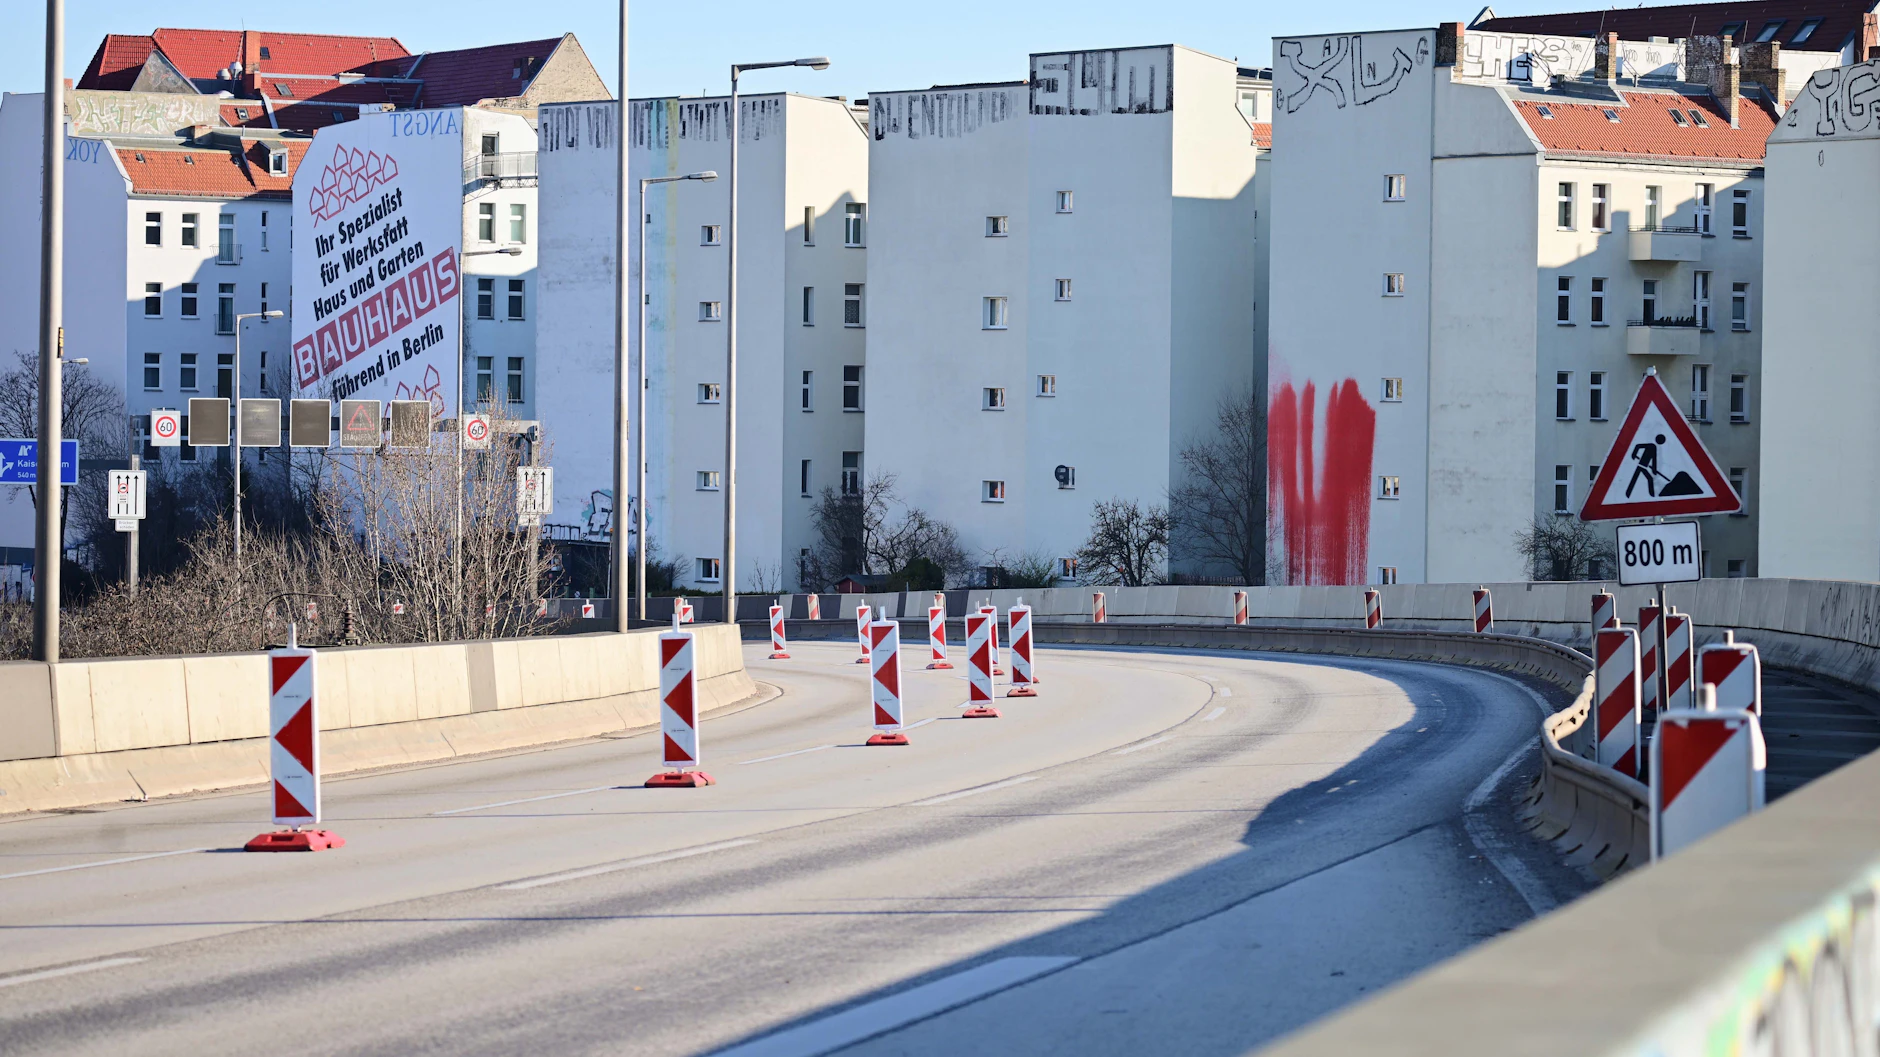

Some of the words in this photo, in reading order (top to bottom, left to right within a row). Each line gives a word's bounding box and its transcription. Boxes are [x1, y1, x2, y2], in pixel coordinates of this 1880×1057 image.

[315, 232, 338, 259] Ihr
[339, 187, 404, 245] Spezialist
[320, 261, 340, 288] für
[342, 216, 409, 274] Werkstatt
[313, 286, 347, 322] Haus
[349, 266, 375, 300] und
[378, 240, 425, 280] Garten
[295, 252, 458, 386] BAUHAUS
[332, 358, 385, 404] führend
[387, 349, 400, 372] in
[402, 322, 445, 362] Berlin
[160, 421, 172, 432] 60
[471, 425, 484, 435] 60
[1624, 538, 1664, 567] 800
[1672, 543, 1693, 565] m
